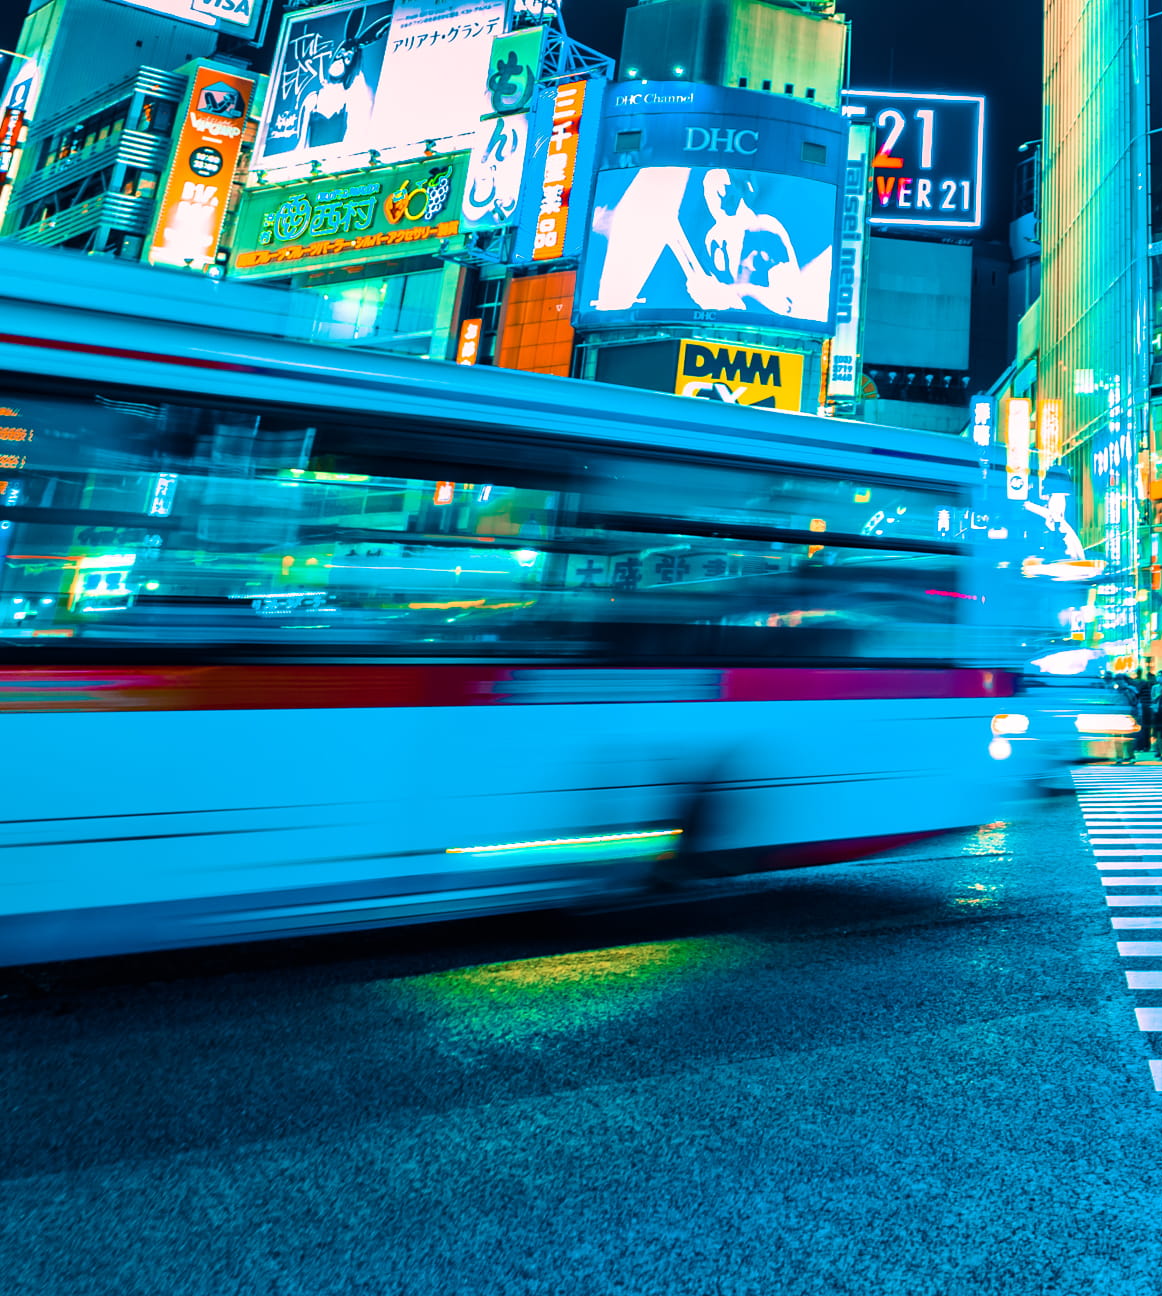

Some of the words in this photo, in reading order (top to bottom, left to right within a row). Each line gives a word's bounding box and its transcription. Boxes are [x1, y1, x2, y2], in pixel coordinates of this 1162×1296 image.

[392, 17, 501, 53] アリアナ・グランデ
[615, 94, 642, 106] DHC
[643, 92, 694, 104] Channel
[683, 126, 760, 155] DHC
[842, 106, 934, 169] 21
[940, 180, 970, 210] 21
[310, 196, 378, 237] 西村
[692, 310, 717, 321] DHC
[683, 343, 782, 388] DMM
